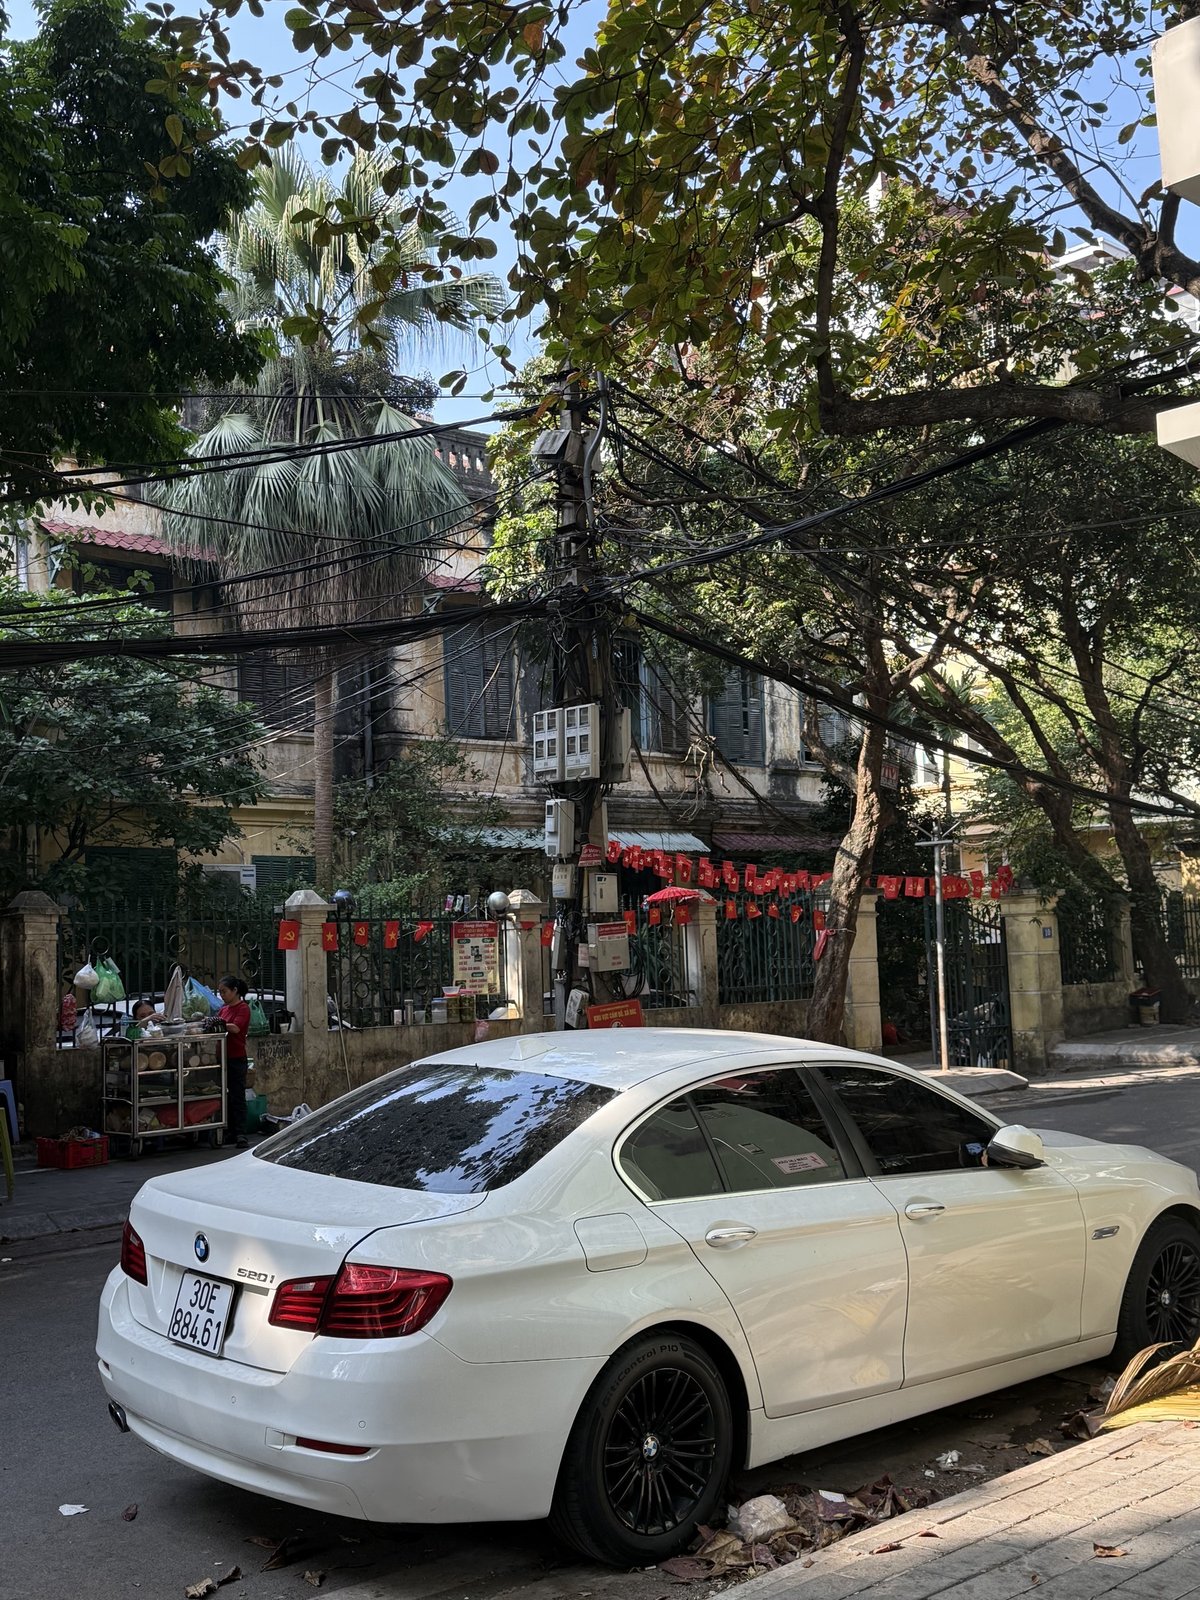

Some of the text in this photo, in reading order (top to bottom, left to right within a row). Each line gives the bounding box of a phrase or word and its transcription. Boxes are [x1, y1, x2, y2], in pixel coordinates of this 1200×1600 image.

[237, 1268, 275, 1283] 520i
[189, 1280, 220, 1314] 30E
[172, 1307, 221, 1350] 884.61
[660, 1344, 679, 1352] P10
